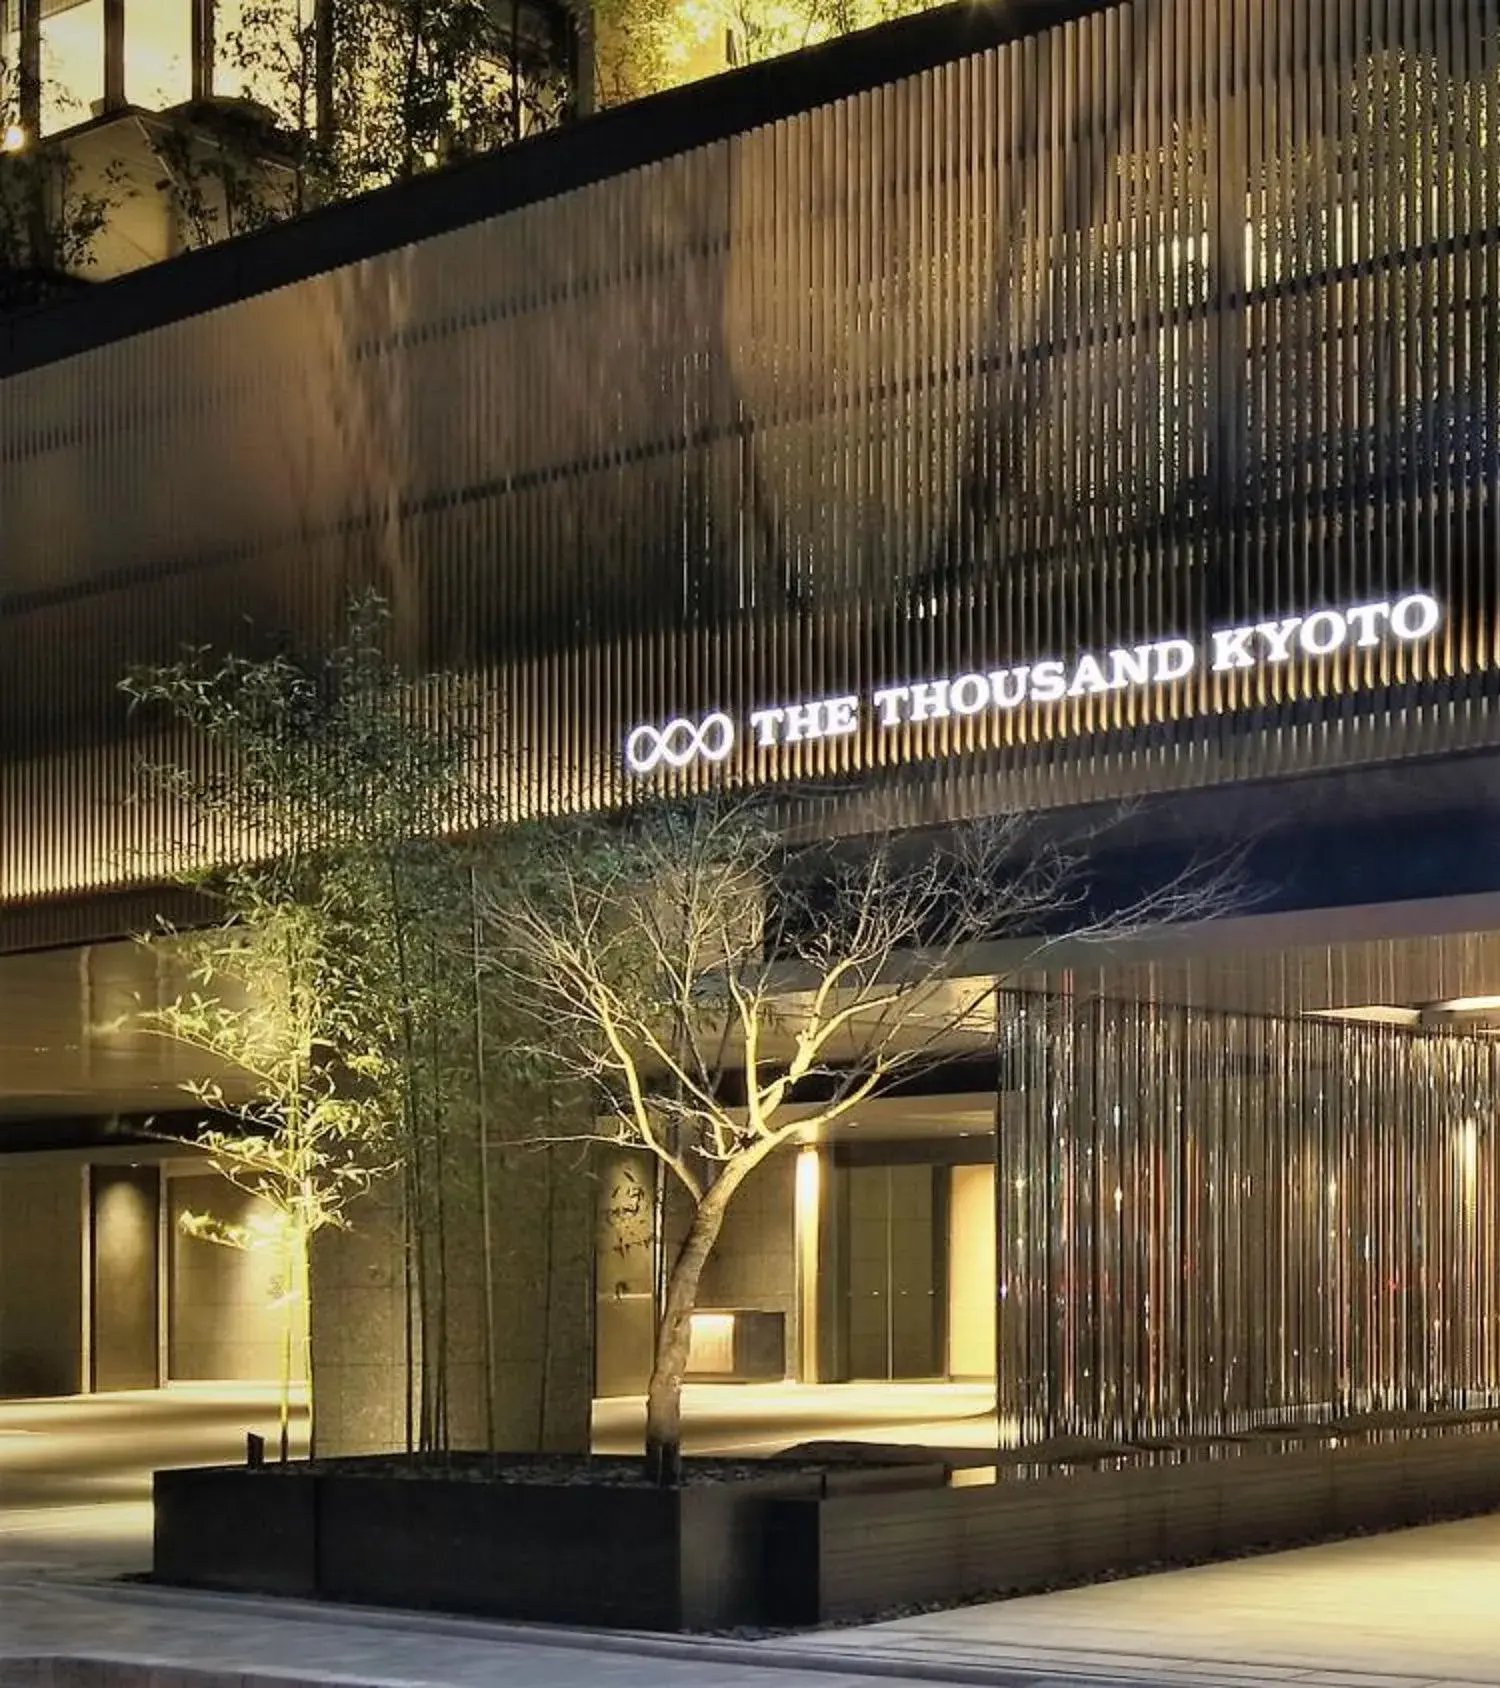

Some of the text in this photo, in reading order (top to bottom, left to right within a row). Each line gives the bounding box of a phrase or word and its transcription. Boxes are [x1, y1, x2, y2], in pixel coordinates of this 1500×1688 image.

[749, 592, 1440, 748] THE THOUSAND KYOTO
